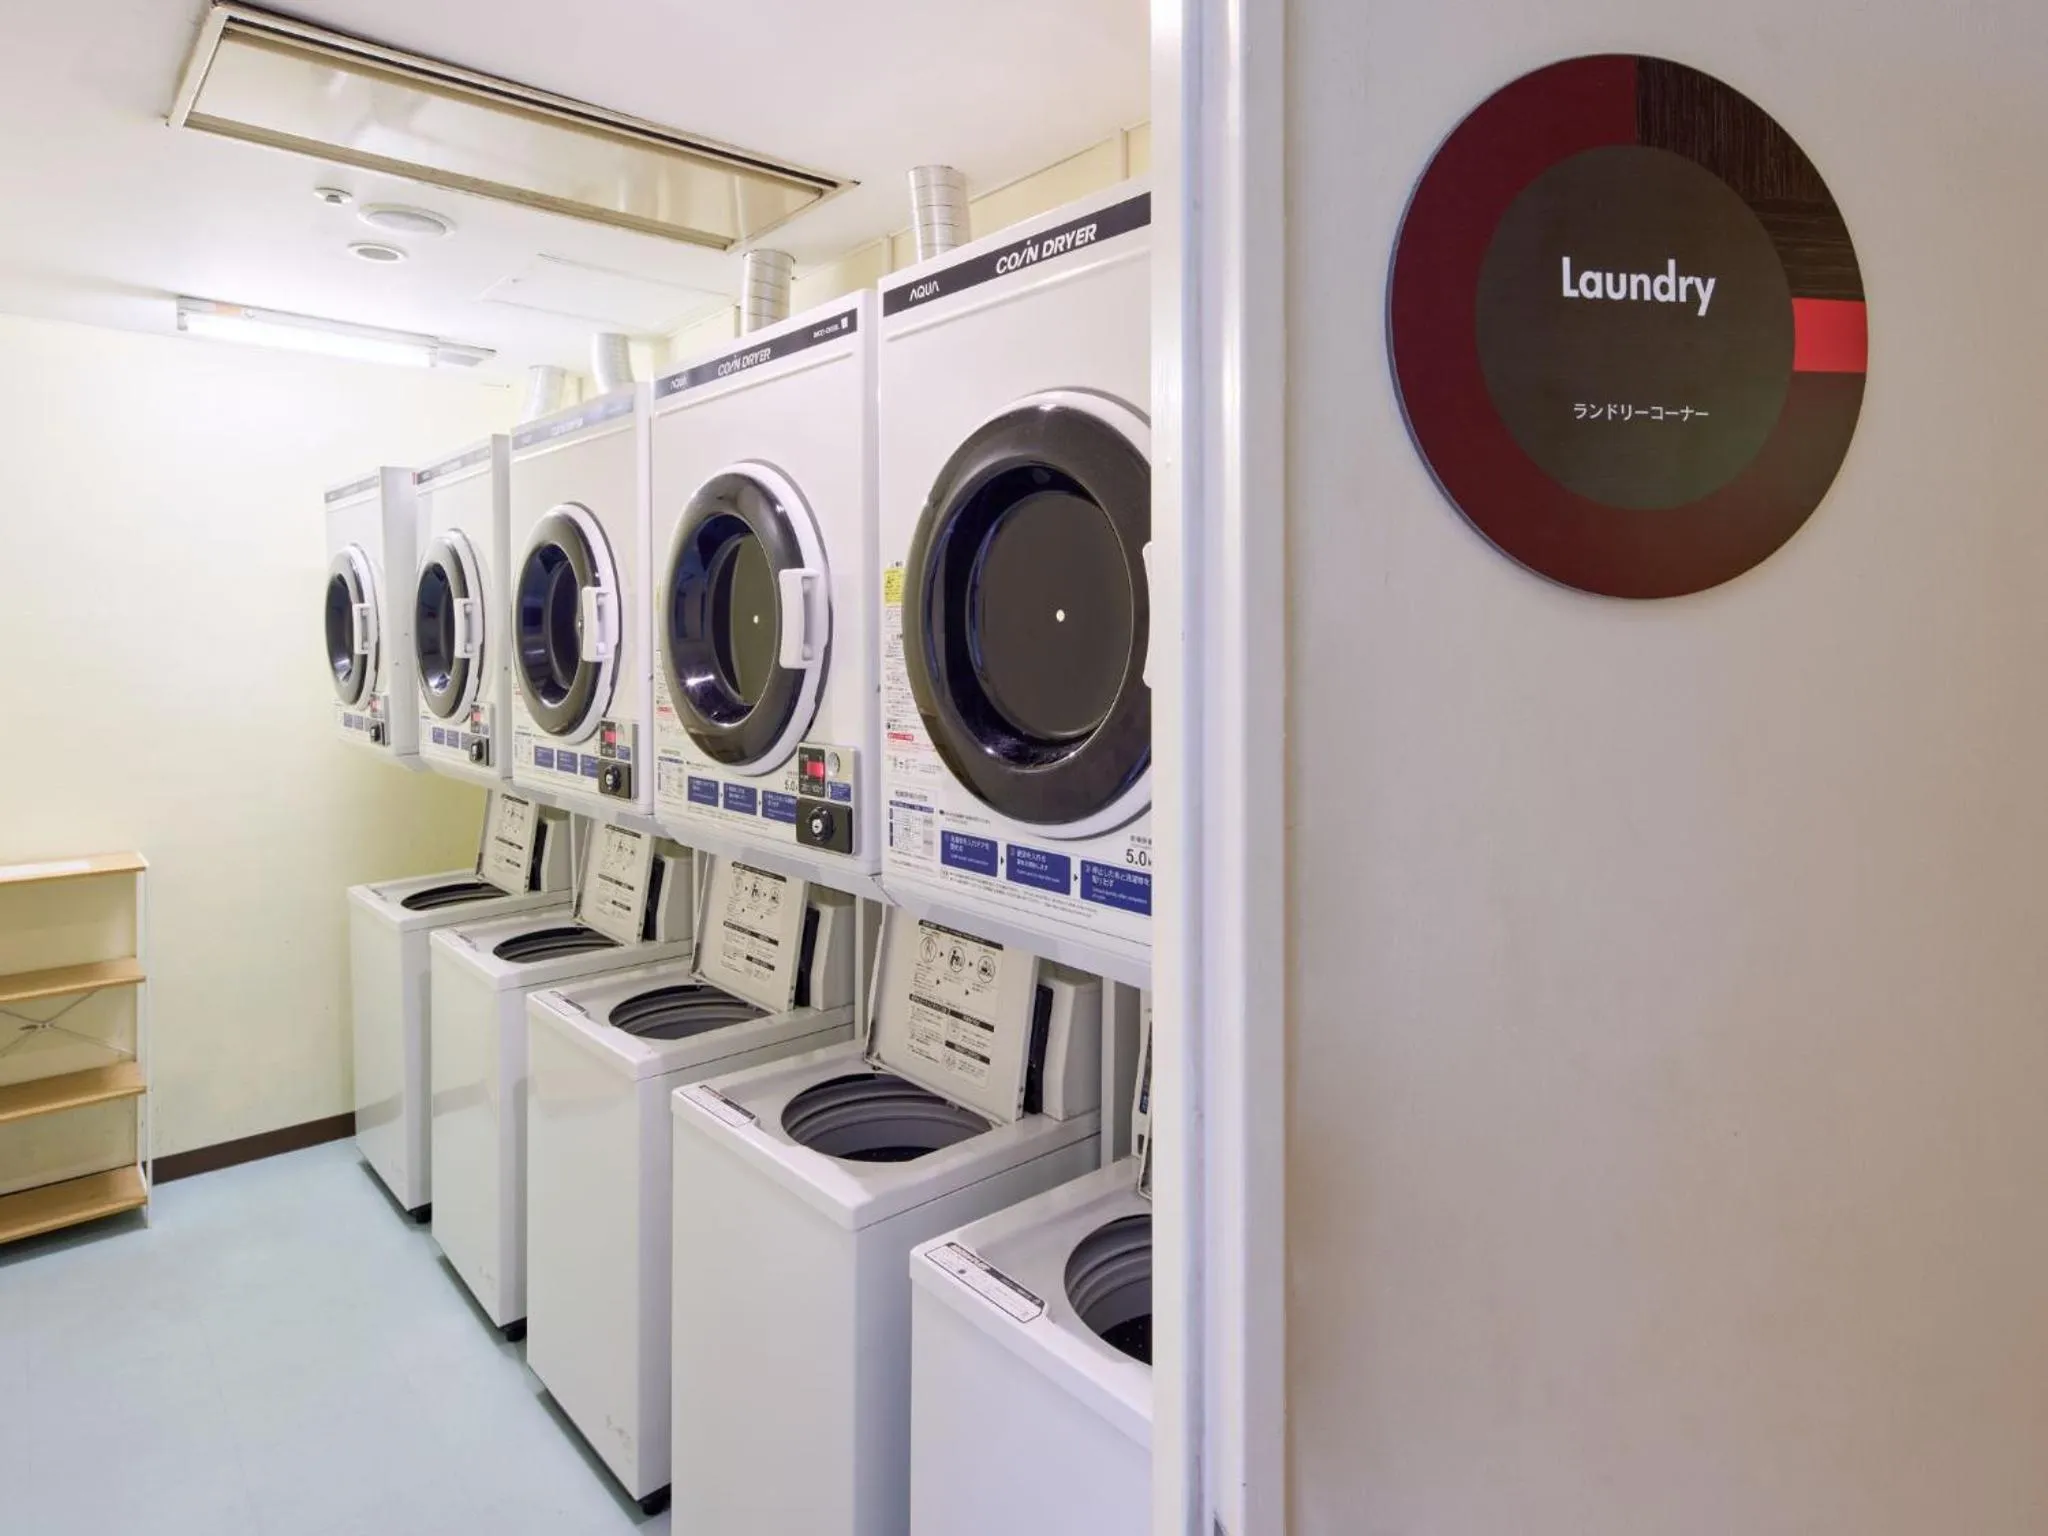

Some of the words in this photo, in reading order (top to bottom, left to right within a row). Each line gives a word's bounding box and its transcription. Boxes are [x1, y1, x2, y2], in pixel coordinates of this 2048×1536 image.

[996, 240, 1039, 275] COIN
[1041, 223, 1098, 258] DRYER
[909, 280, 940, 302] AQUA
[1561, 256, 1716, 317] Laundry
[742, 347, 771, 368] DRYER
[1573, 403, 1709, 422] ランドリーコーナー
